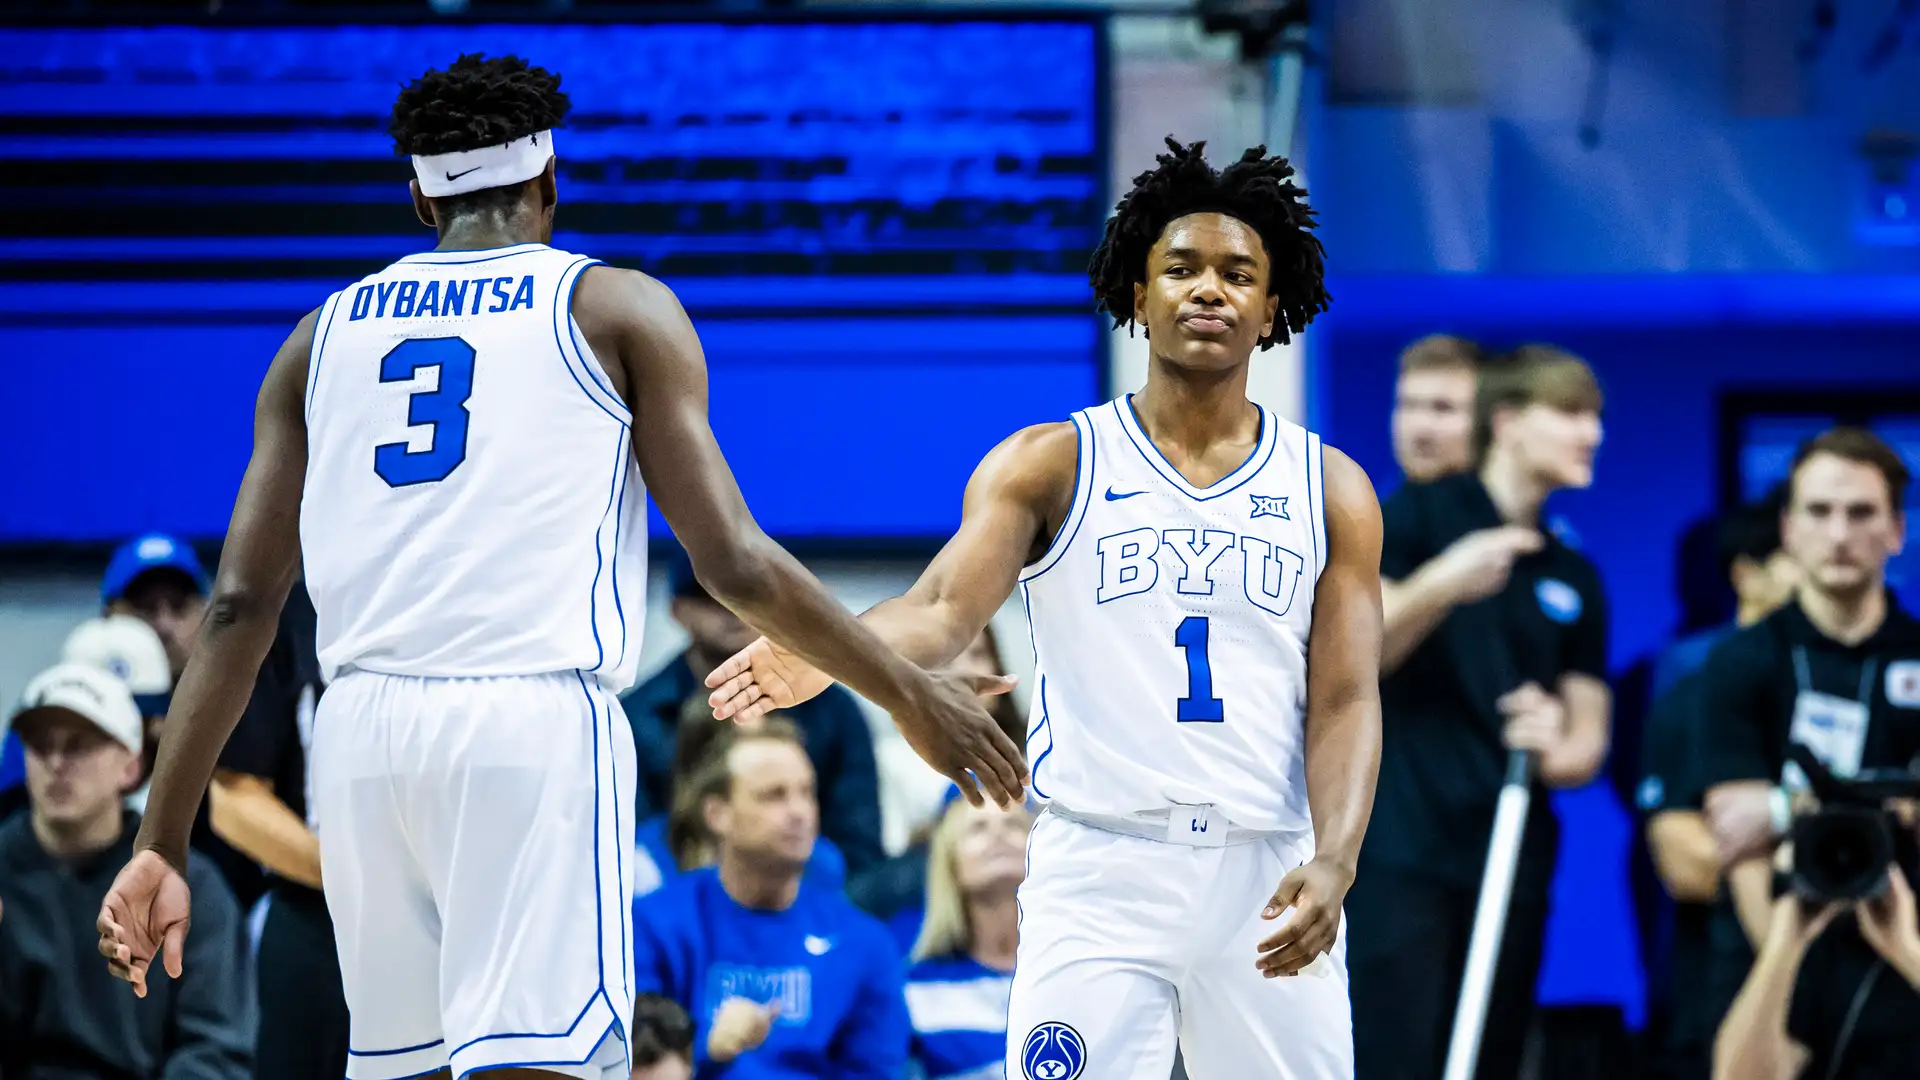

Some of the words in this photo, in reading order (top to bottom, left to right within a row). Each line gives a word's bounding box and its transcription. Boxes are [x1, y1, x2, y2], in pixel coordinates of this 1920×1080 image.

[349, 275, 534, 322] DYBANTSA
[374, 336, 477, 488] 3
[1249, 494, 1290, 520] XII
[1097, 527, 1304, 616] BYU
[1175, 616, 1224, 722] 1
[1040, 1062, 1061, 1077] Y
